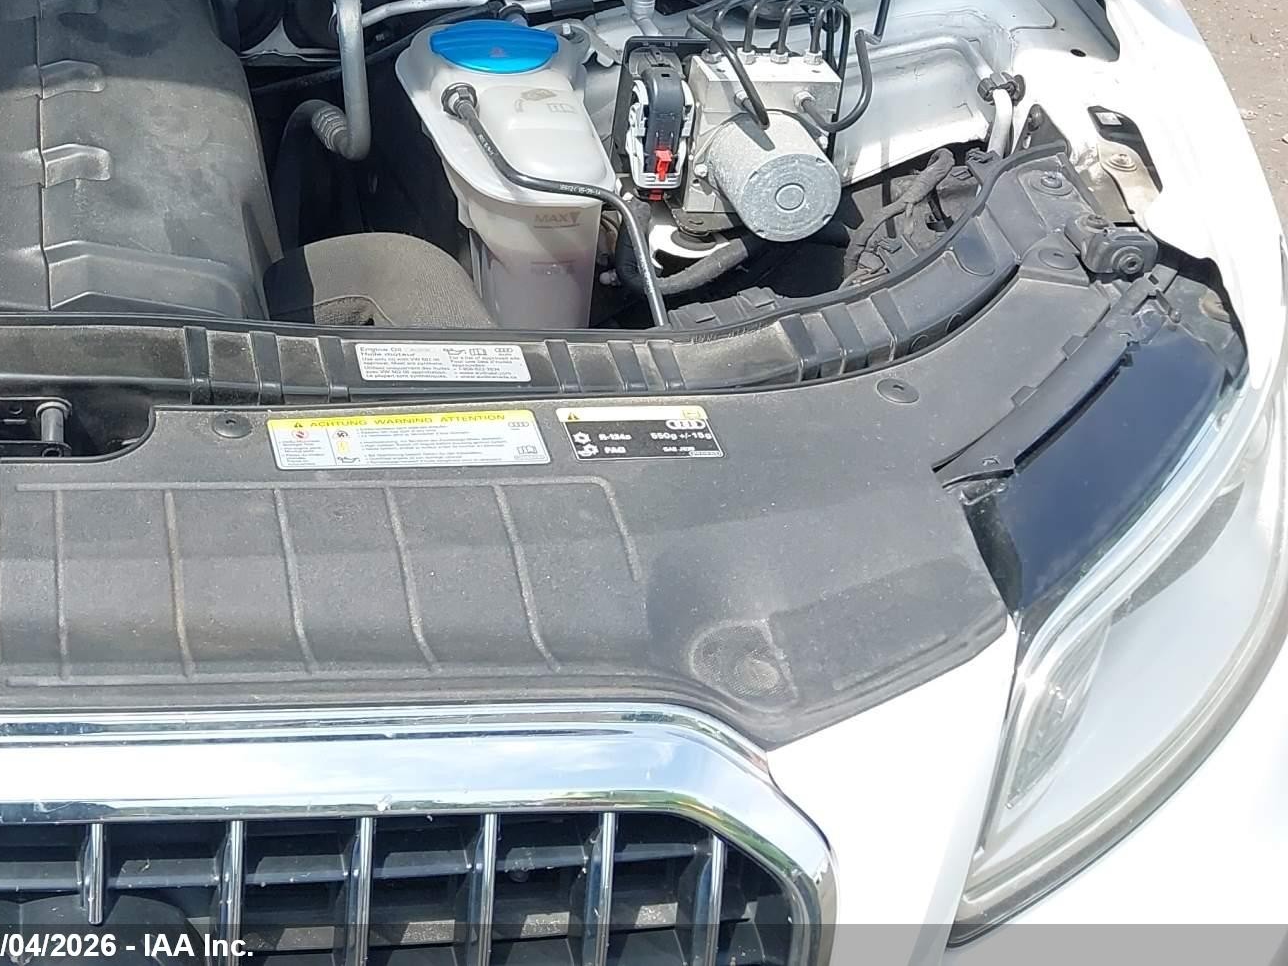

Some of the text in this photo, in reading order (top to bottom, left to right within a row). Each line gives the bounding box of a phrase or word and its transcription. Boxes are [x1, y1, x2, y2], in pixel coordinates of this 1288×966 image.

[535, 212, 569, 223] MAX
[374, 417, 432, 425] WARNING
[440, 414, 505, 422] ATTENTION
[650, 432, 678, 440] 550g
